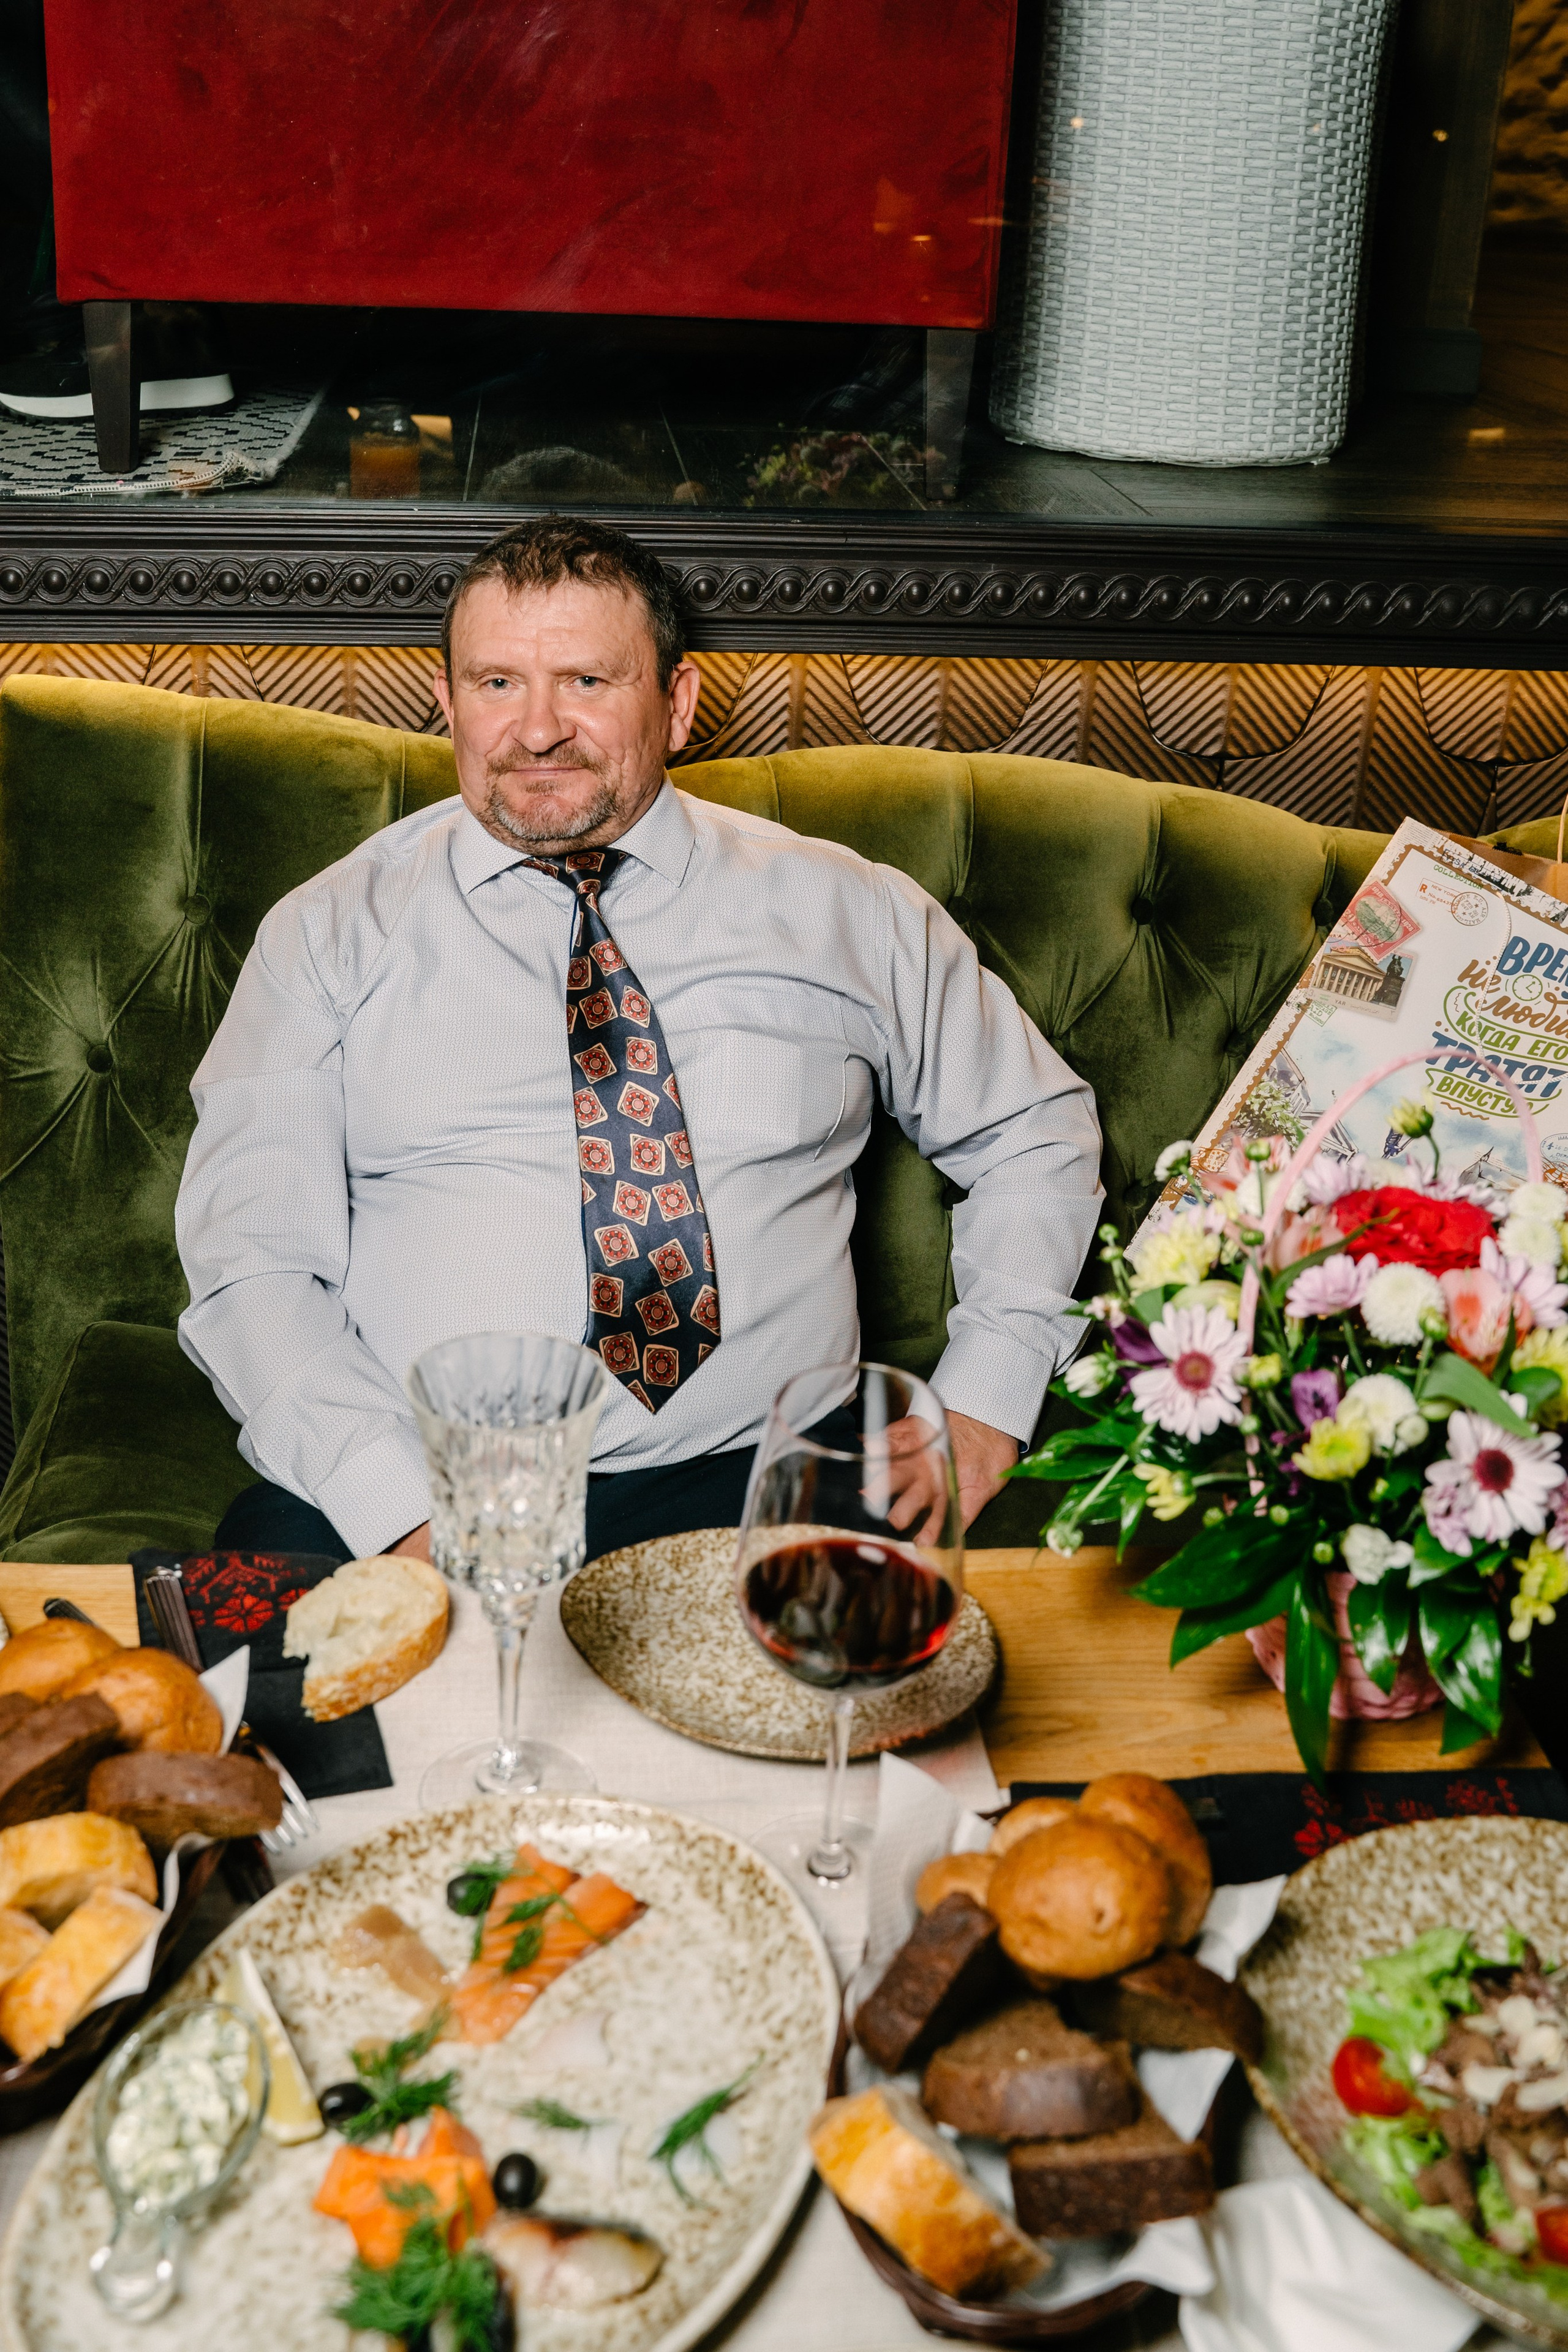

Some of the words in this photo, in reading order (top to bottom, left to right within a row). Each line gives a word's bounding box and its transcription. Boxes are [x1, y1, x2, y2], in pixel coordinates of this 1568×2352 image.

[1419, 884, 1428, 893] R
[1433, 864, 1483, 890] COLLECTION
[1401, 919, 1414, 932] 1928
[1475, 992, 1568, 1039] люби
[1455, 1011, 1521, 1051] КОГДА
[1528, 1039, 1568, 1060] ЕГО
